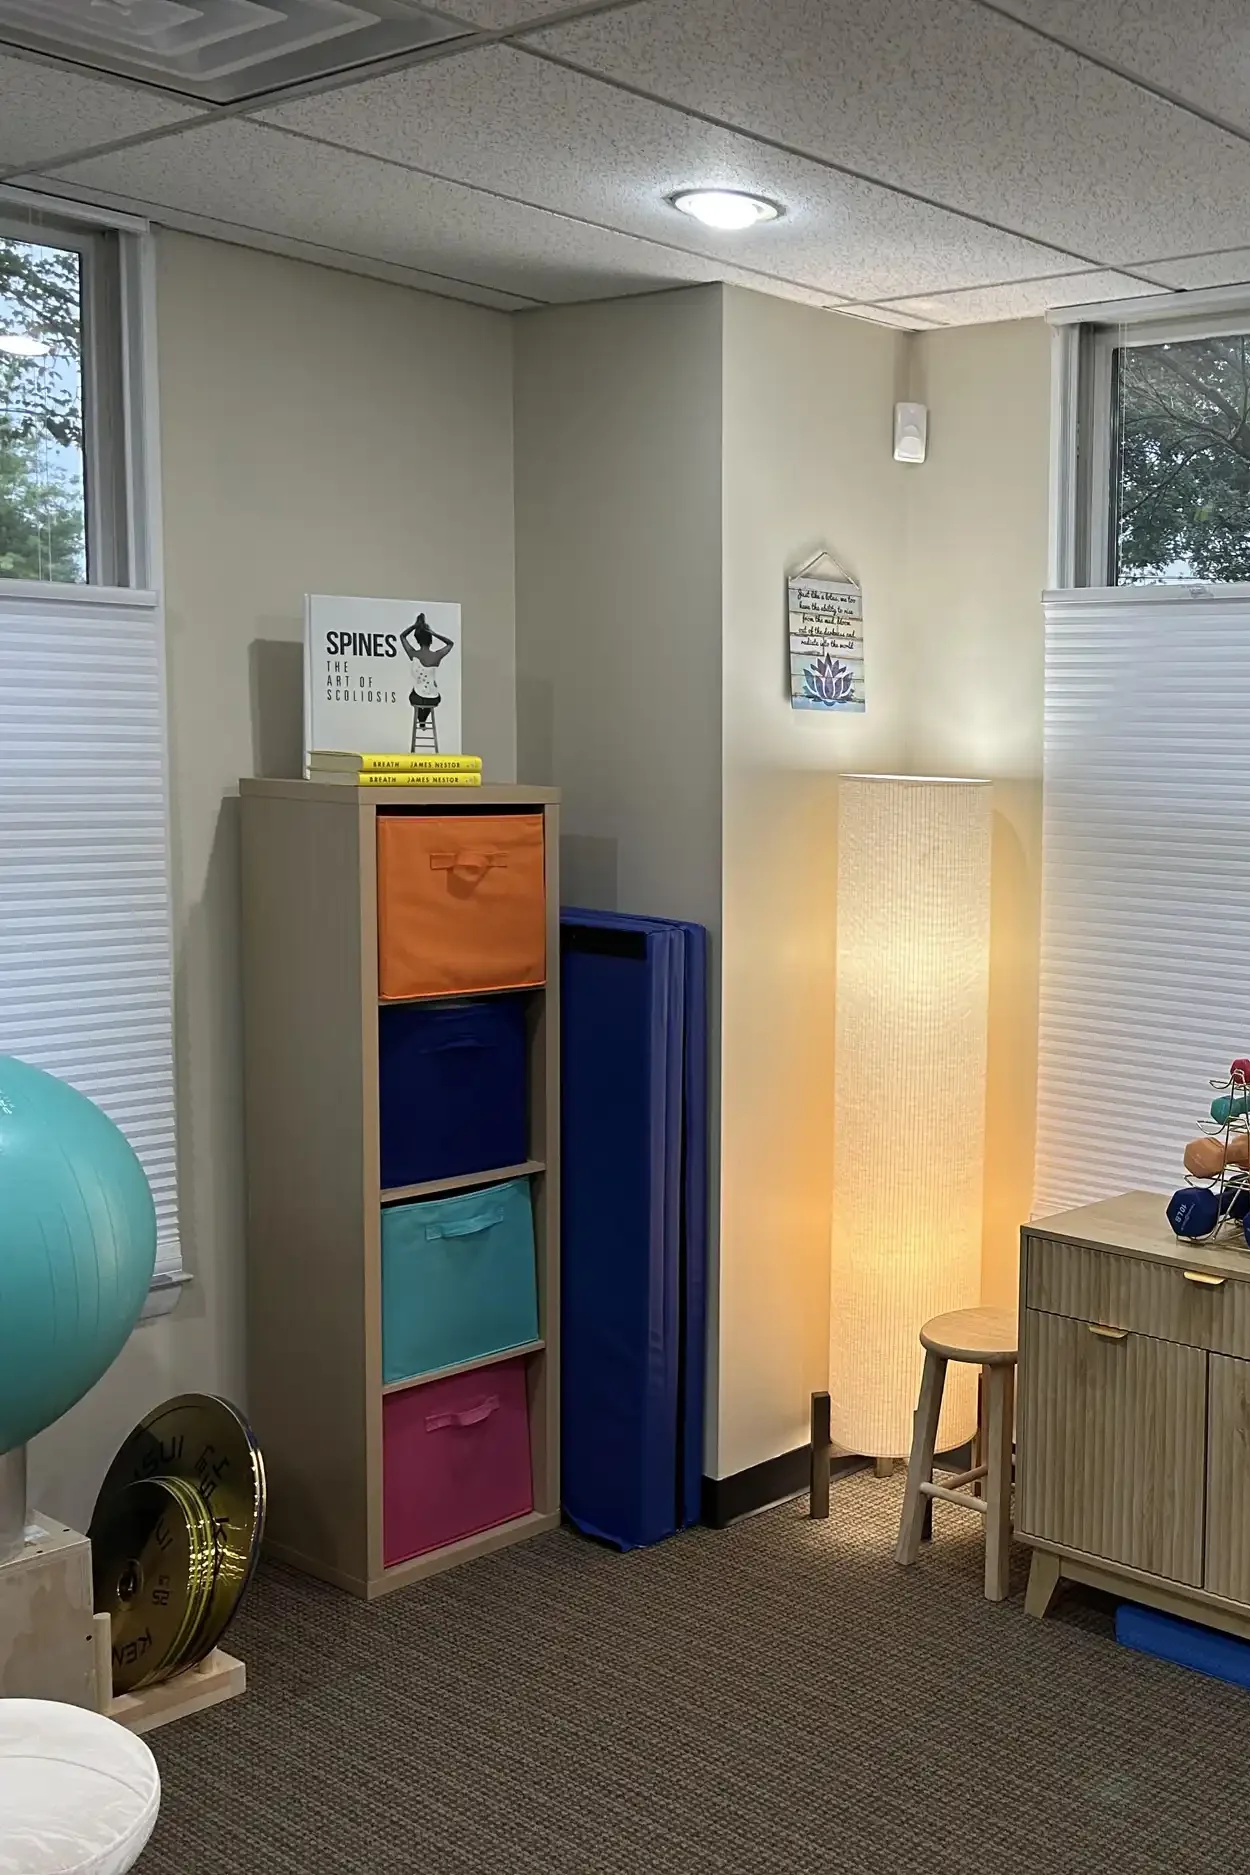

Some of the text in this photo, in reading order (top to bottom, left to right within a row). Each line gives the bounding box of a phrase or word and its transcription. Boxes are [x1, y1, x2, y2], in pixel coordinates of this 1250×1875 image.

[326, 631, 397, 658] SPINES
[327, 660, 348, 673] THE
[327, 674, 373, 688] ART OF
[327, 689, 396, 703] SCOLIOSIS
[112, 1627, 153, 1668] KEN
